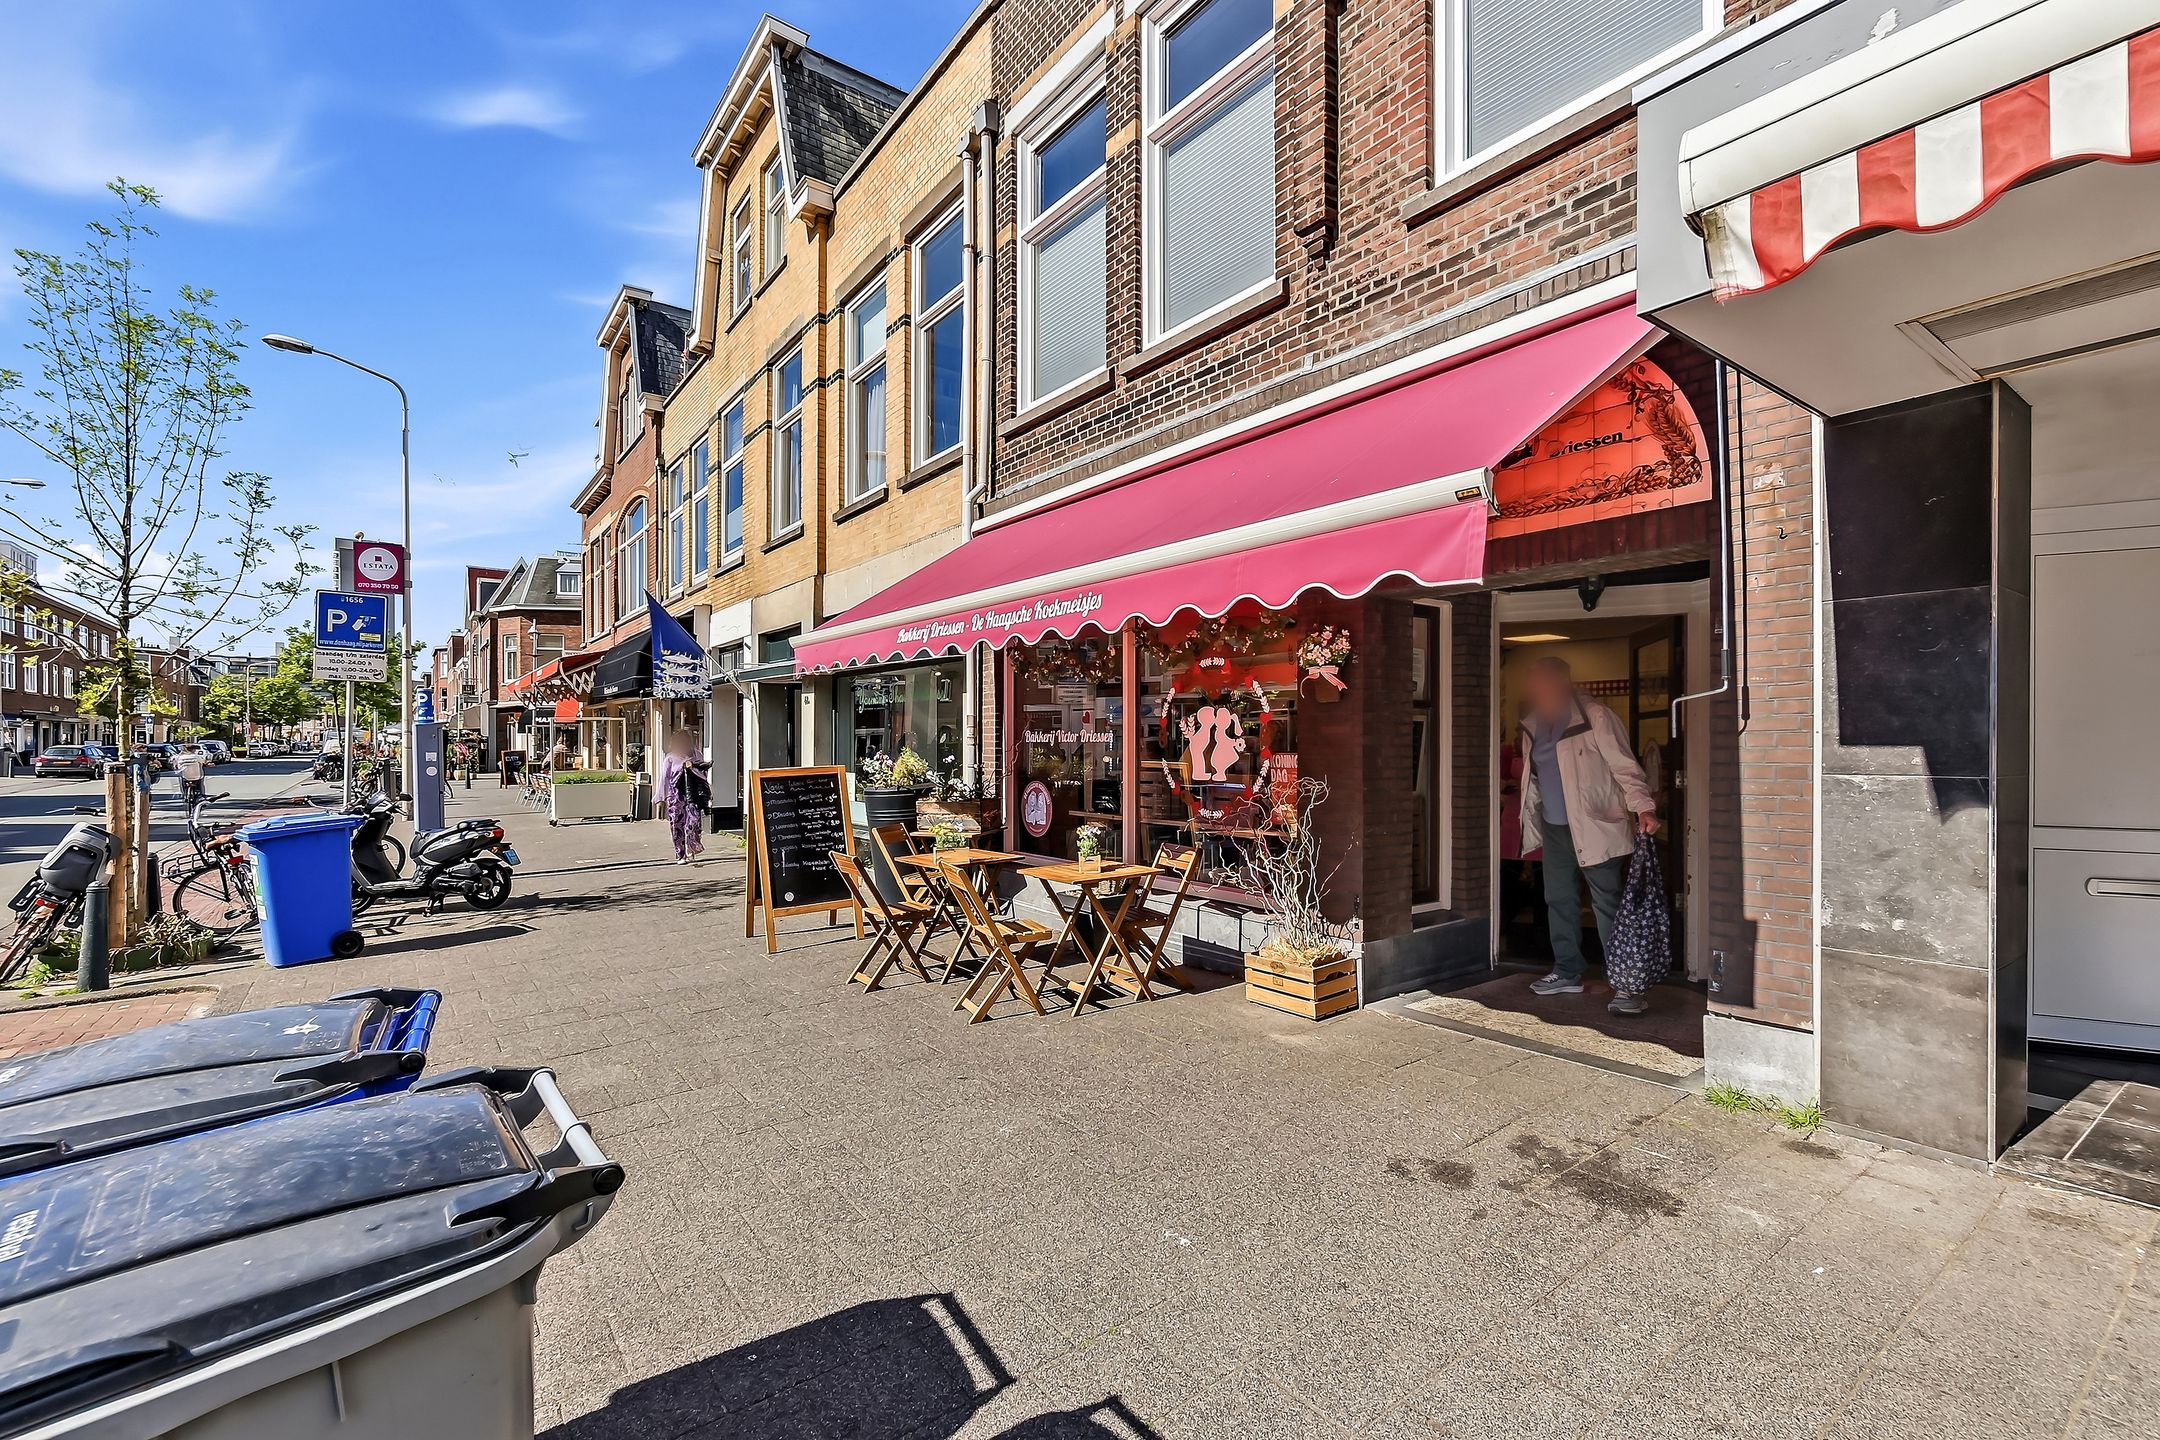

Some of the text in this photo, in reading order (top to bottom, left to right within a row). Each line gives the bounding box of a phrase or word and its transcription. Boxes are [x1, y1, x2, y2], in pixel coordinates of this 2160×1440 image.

[363, 562, 394, 570] ESTATA
[345, 596, 364, 604] 1656
[327, 608, 348, 632] P
[896, 624, 931, 644] Bakkerij
[930, 621, 965, 638] Driessen
[971, 613, 985, 632] De
[985, 605, 1033, 631] Haagsche
[1034, 591, 1103, 618] Koekmeisjes
[1024, 729, 1114, 747] Bakkerij Victor Driessen
[1270, 769, 1288, 782] DAG
